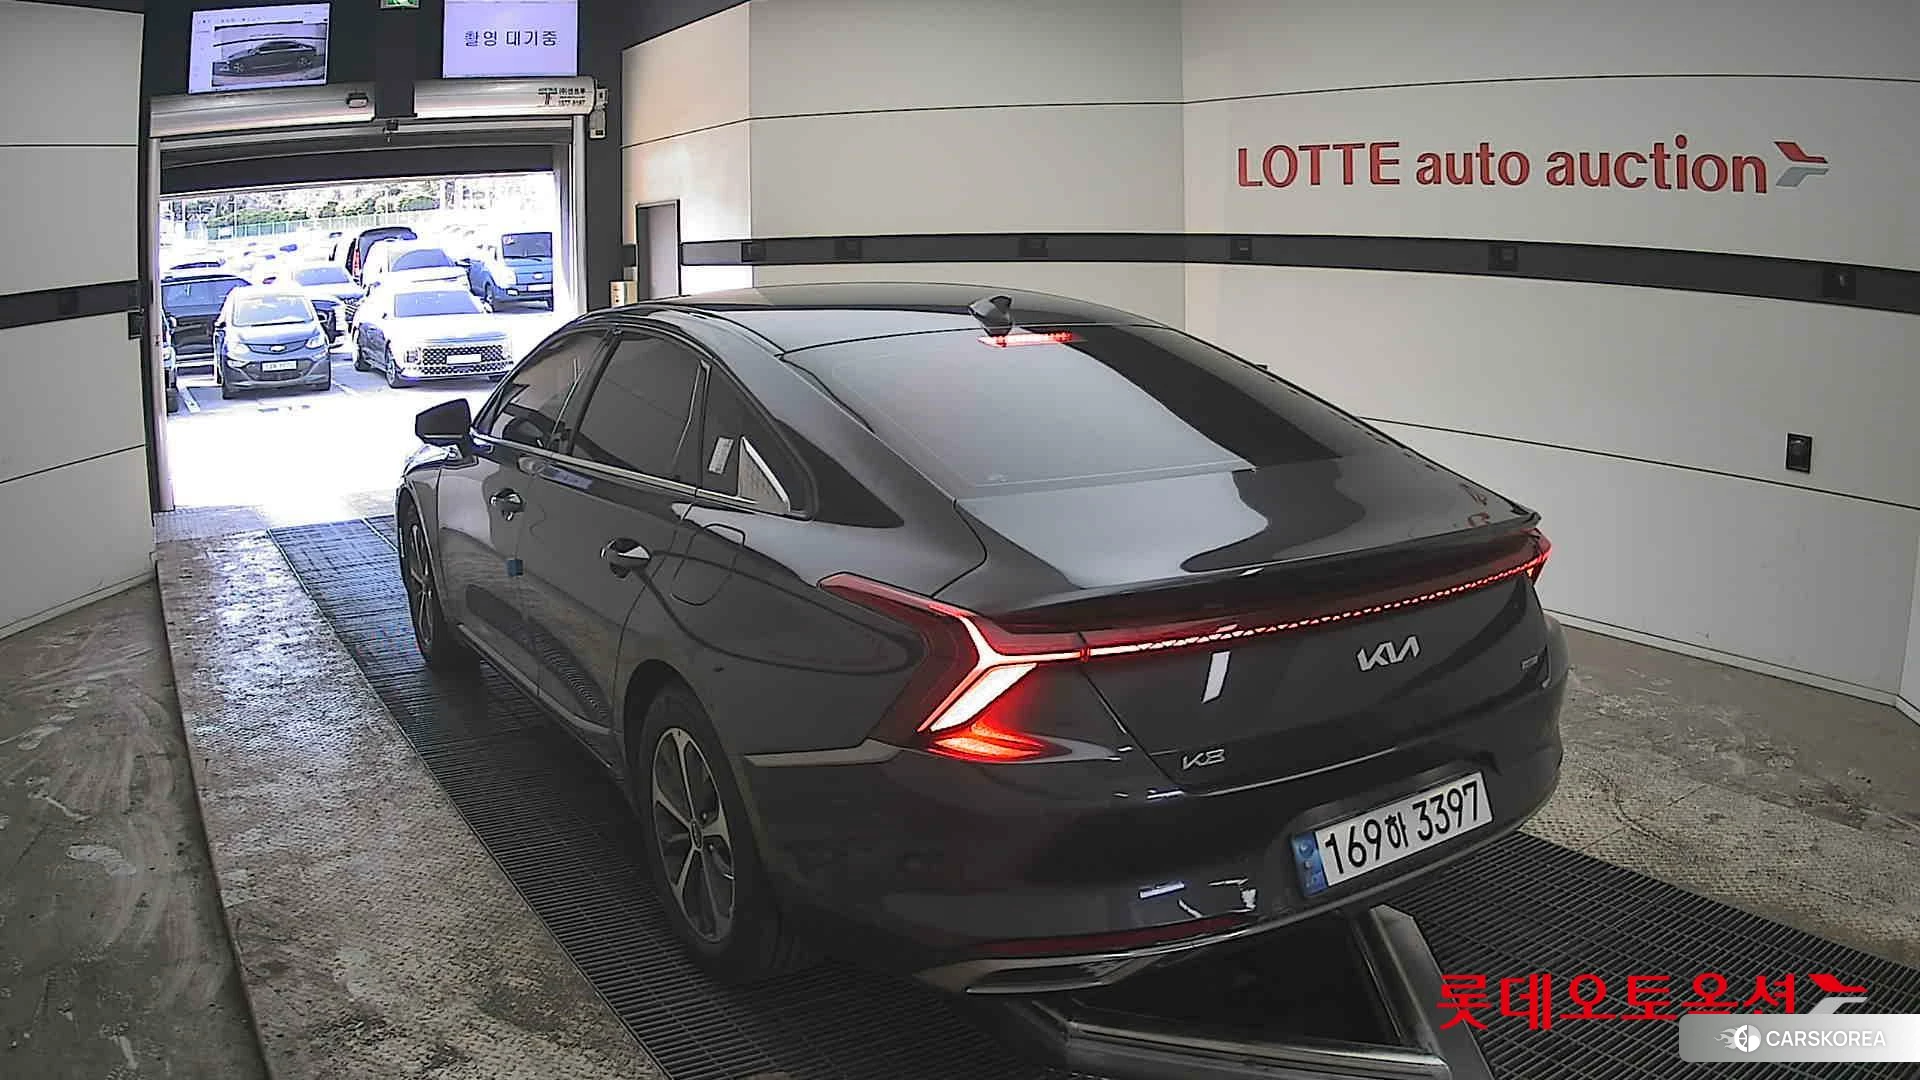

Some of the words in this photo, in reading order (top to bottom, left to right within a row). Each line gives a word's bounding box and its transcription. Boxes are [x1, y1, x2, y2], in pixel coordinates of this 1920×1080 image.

[505, 30, 558, 47] 대기중
[1237, 142, 1400, 187] LOTTE
[1415, 142, 1530, 186] auto
[1546, 135, 1768, 193] auction
[1356, 635, 1421, 672] KIA
[1182, 748, 1226, 770] K8
[1325, 811, 1409, 875] 169하
[1412, 780, 1479, 841] 3397
